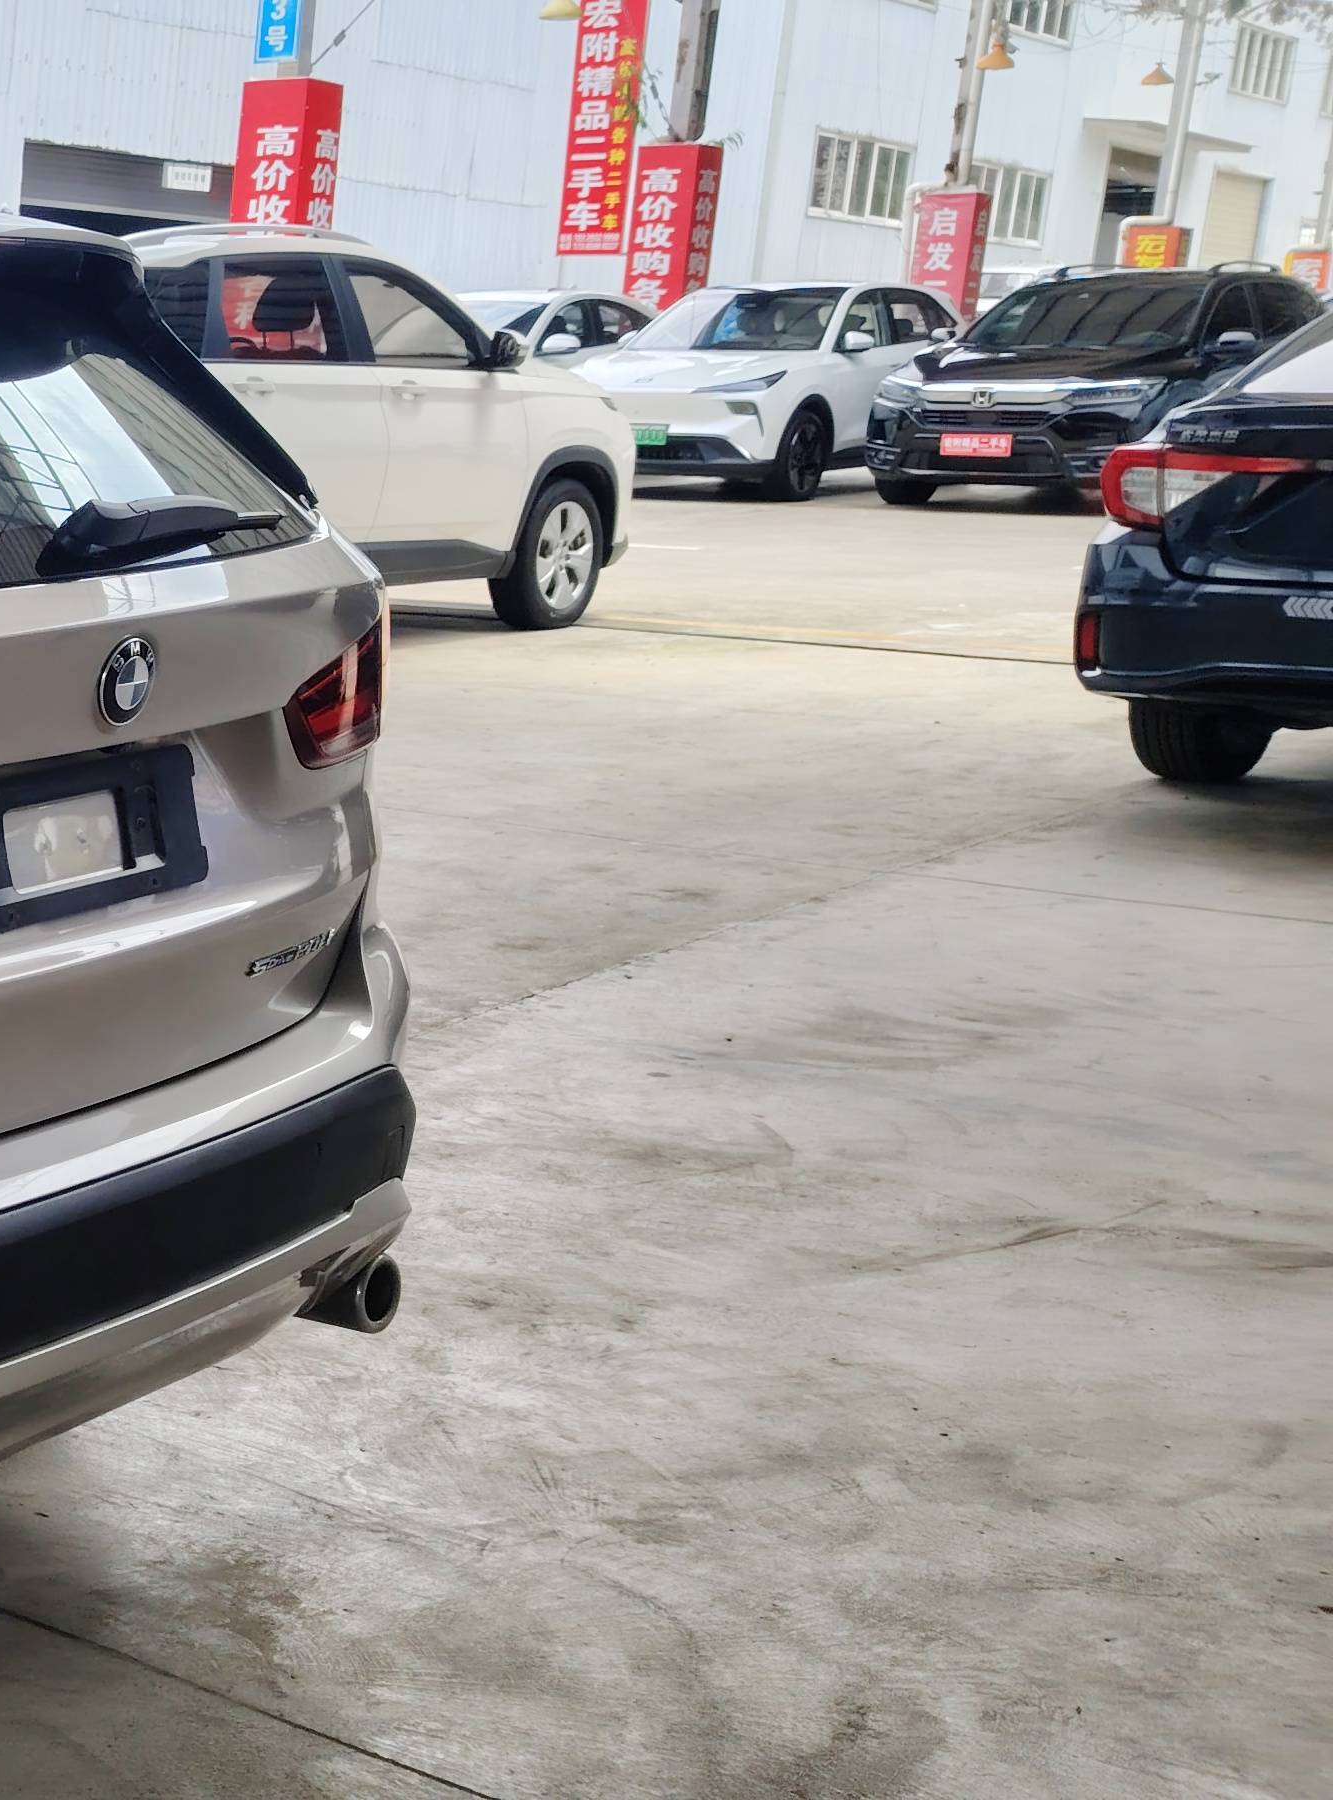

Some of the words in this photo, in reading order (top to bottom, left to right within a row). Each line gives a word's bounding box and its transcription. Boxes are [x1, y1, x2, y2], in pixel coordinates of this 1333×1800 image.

[246, 124, 299, 237] 高价收
[564, 0, 622, 231] 宏附精品二手车
